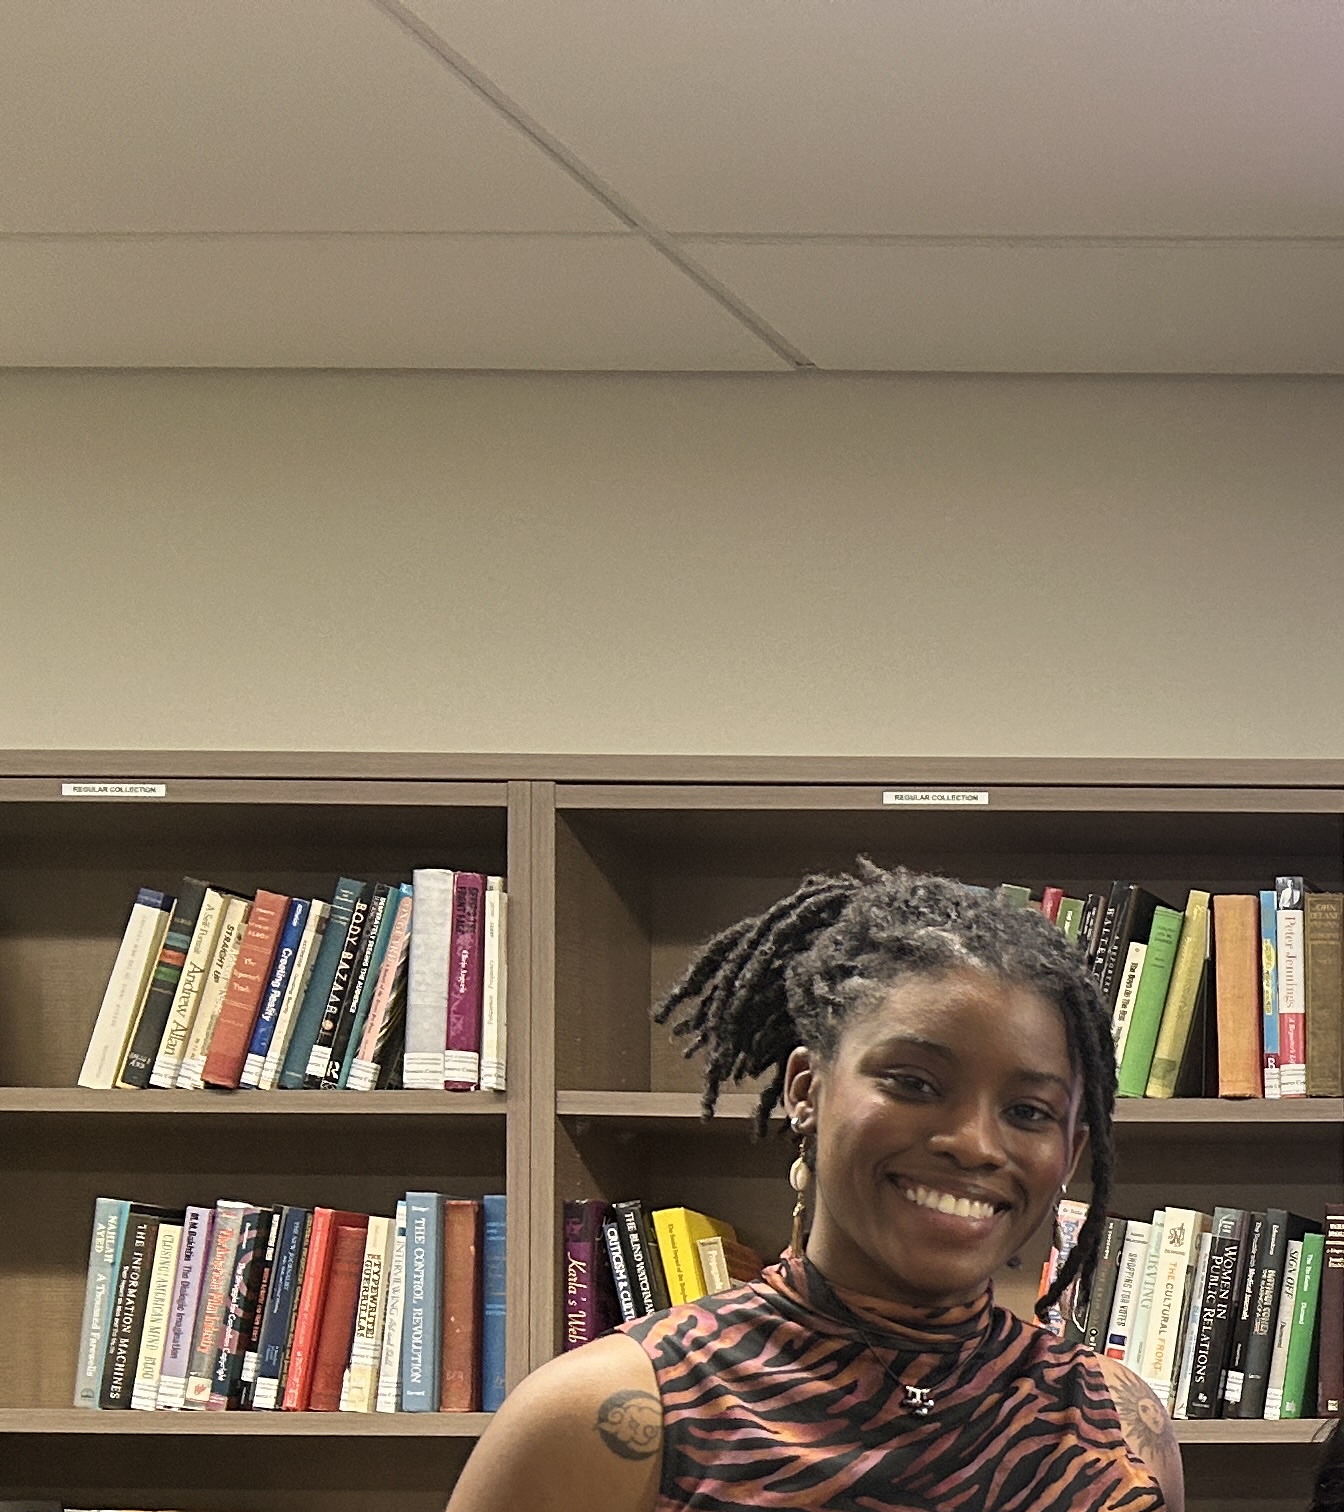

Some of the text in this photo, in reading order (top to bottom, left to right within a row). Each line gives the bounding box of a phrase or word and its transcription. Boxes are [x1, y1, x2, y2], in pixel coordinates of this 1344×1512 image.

[210, 923, 235, 983] STRAIGHT UP
[346, 901, 366, 945] BODY
[1095, 908, 1115, 964] WALTER
[260, 946, 292, 1022] Creating Reality
[325, 949, 352, 1015] BAZAAR
[1283, 916, 1298, 1008] Peter Jennings
[162, 960, 205, 1058] Andrew Allan
[93, 1222, 107, 1253] AYED
[102, 1214, 119, 1263] NAHLAH
[181, 1265, 192, 1279] The
[236, 1262, 244, 1272] The
[605, 1226, 635, 1321] CRITICISM & CULTU
[623, 1211, 656, 1317] THE BLIND WATCHMAK
[1285, 1248, 1299, 1276] SIGN
[108, 1223, 147, 1400] THE INFORMATION MACHINES
[141, 1233, 174, 1380] CLOSING AMERICAN MIND BLOO
[205, 1290, 225, 1315] Film
[387, 1239, 407, 1316] INTERVIEWING
[410, 1217, 425, 1383] THE CONTROL REVOLUTION
[564, 1251, 588, 1343] Karla's Web
[1116, 1252, 1137, 1327] SHOPPING FOR VOTES
[1139, 1252, 1160, 1309] IRVING
[1215, 1243, 1237, 1320] WOMEN IN
[1281, 1276, 1295, 1299] OFF
[84, 1272, 106, 1377] A Thousand Farewells
[1152, 1261, 1177, 1371] THE CULTURAL FRONT
[1191, 1254, 1223, 1384] PUBLIC RELATIONS
